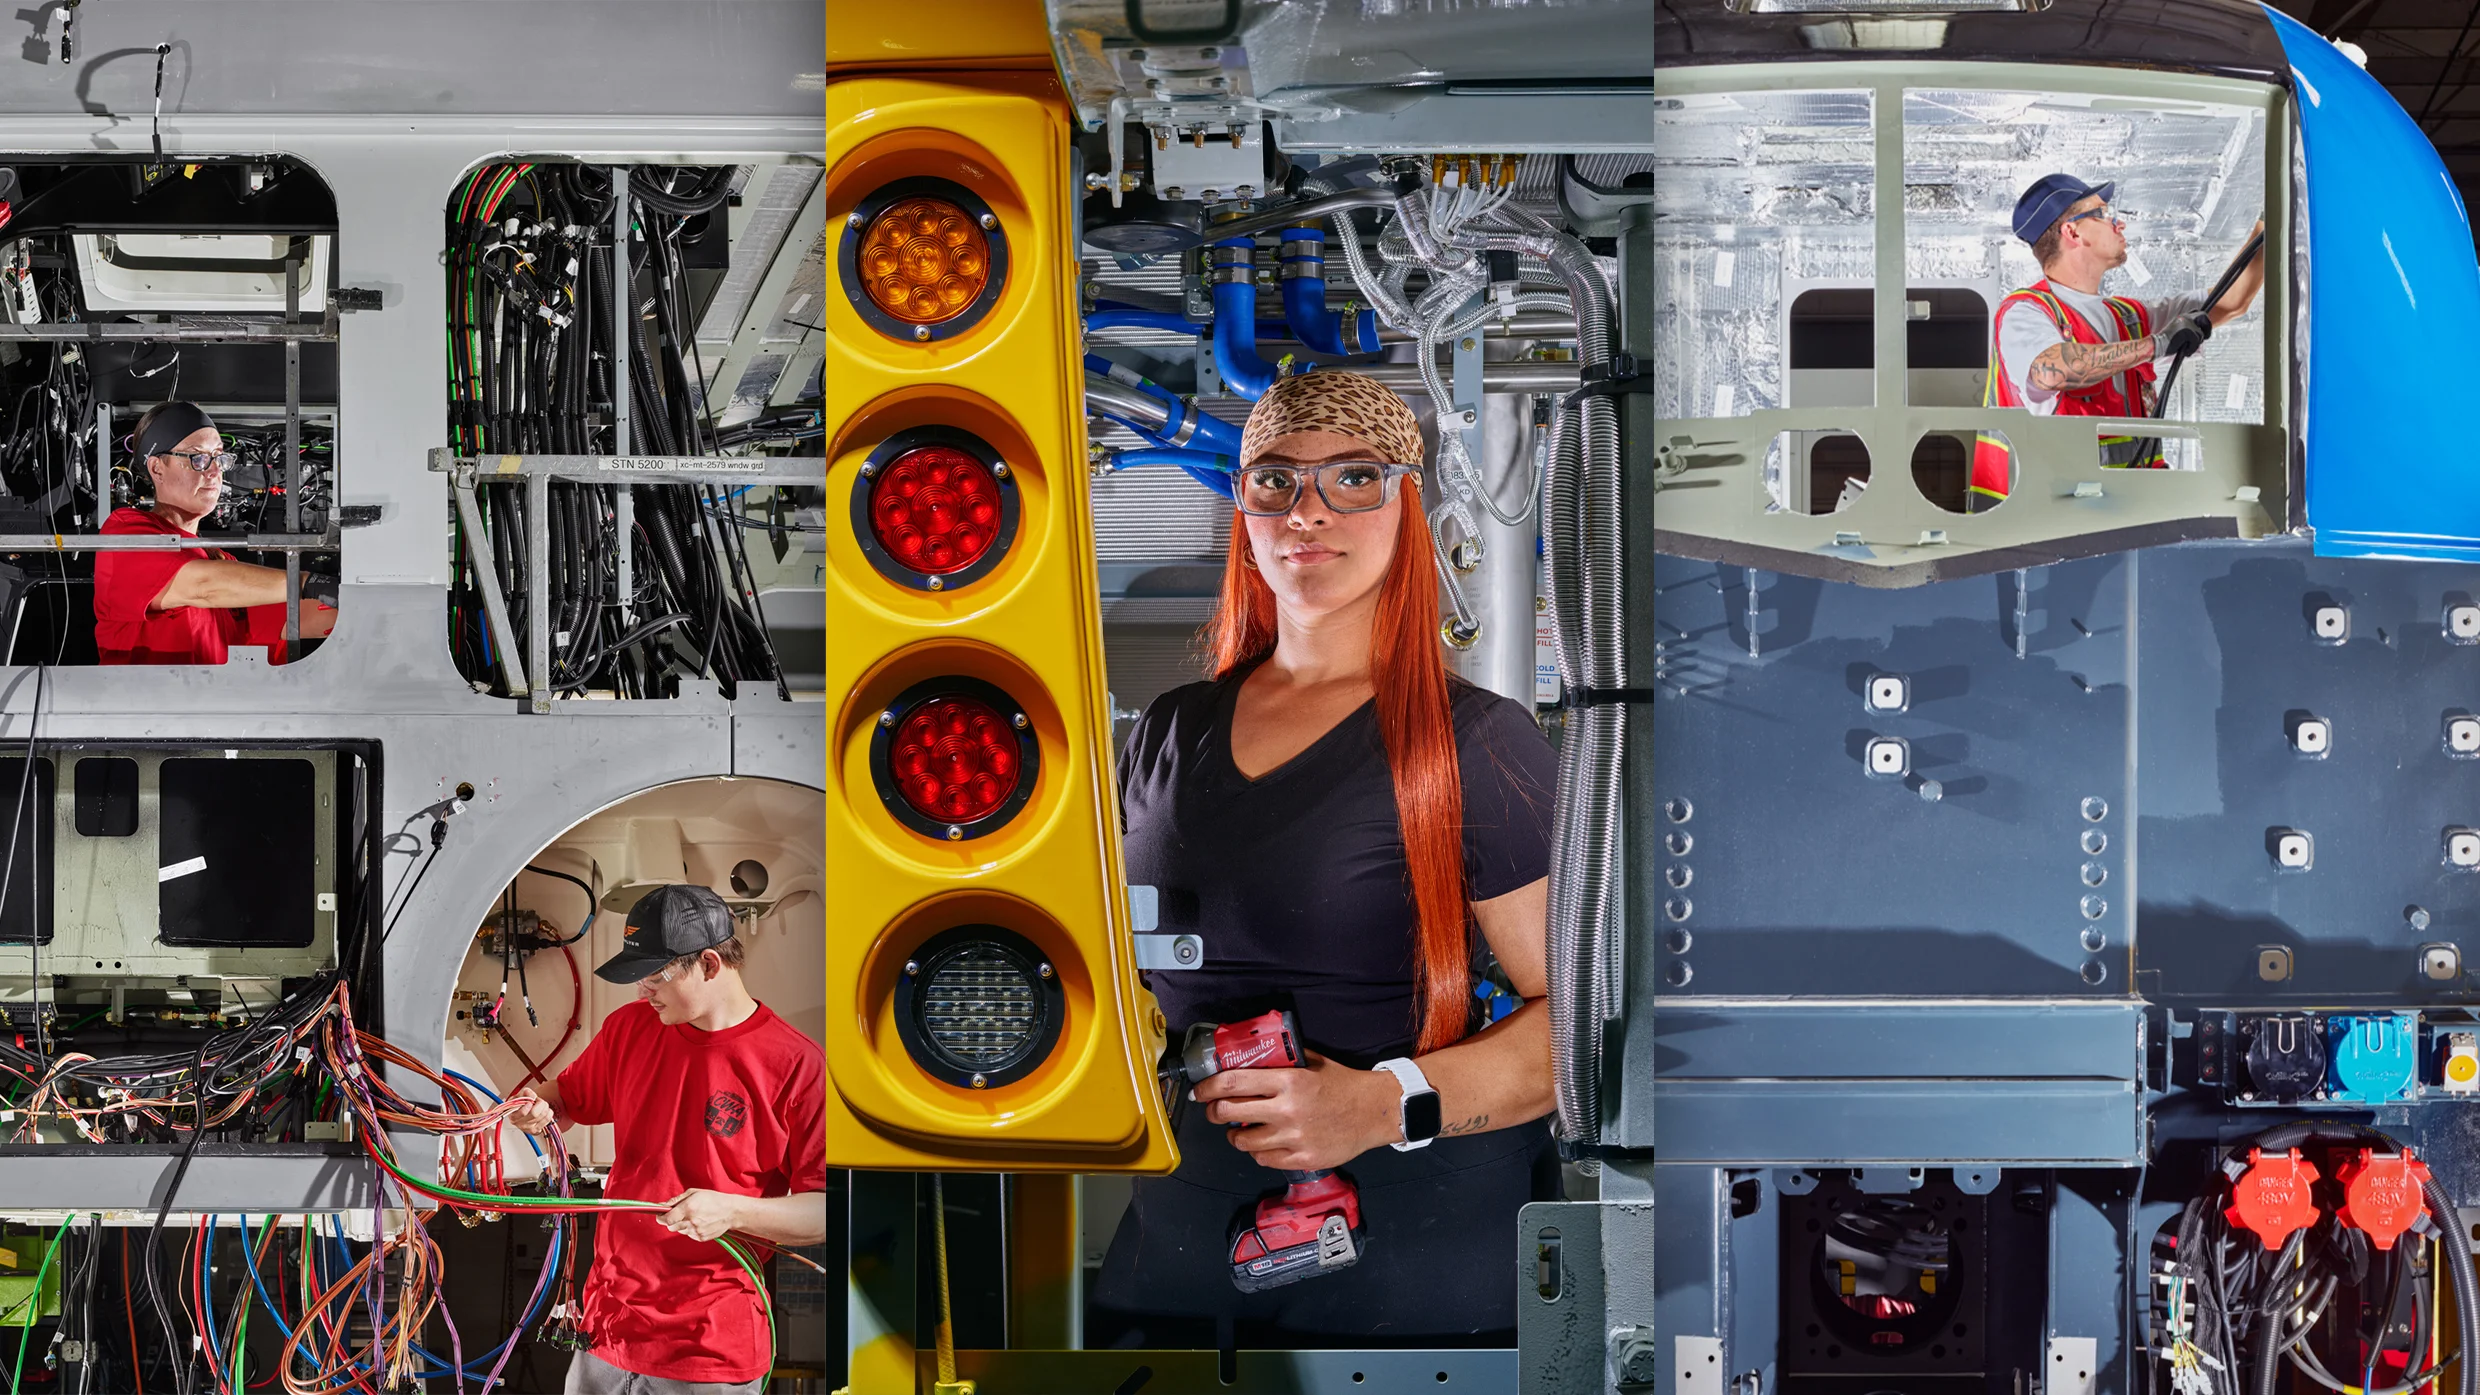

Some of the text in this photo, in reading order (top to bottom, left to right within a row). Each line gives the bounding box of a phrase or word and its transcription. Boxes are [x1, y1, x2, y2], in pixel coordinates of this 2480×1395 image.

[611, 459, 664, 469] STN 5200
[680, 461, 764, 470] xc-mt-2579 wndw grd
[1222, 1037, 1276, 1068] Milwaukee
[713, 1096, 746, 1118] CWA
